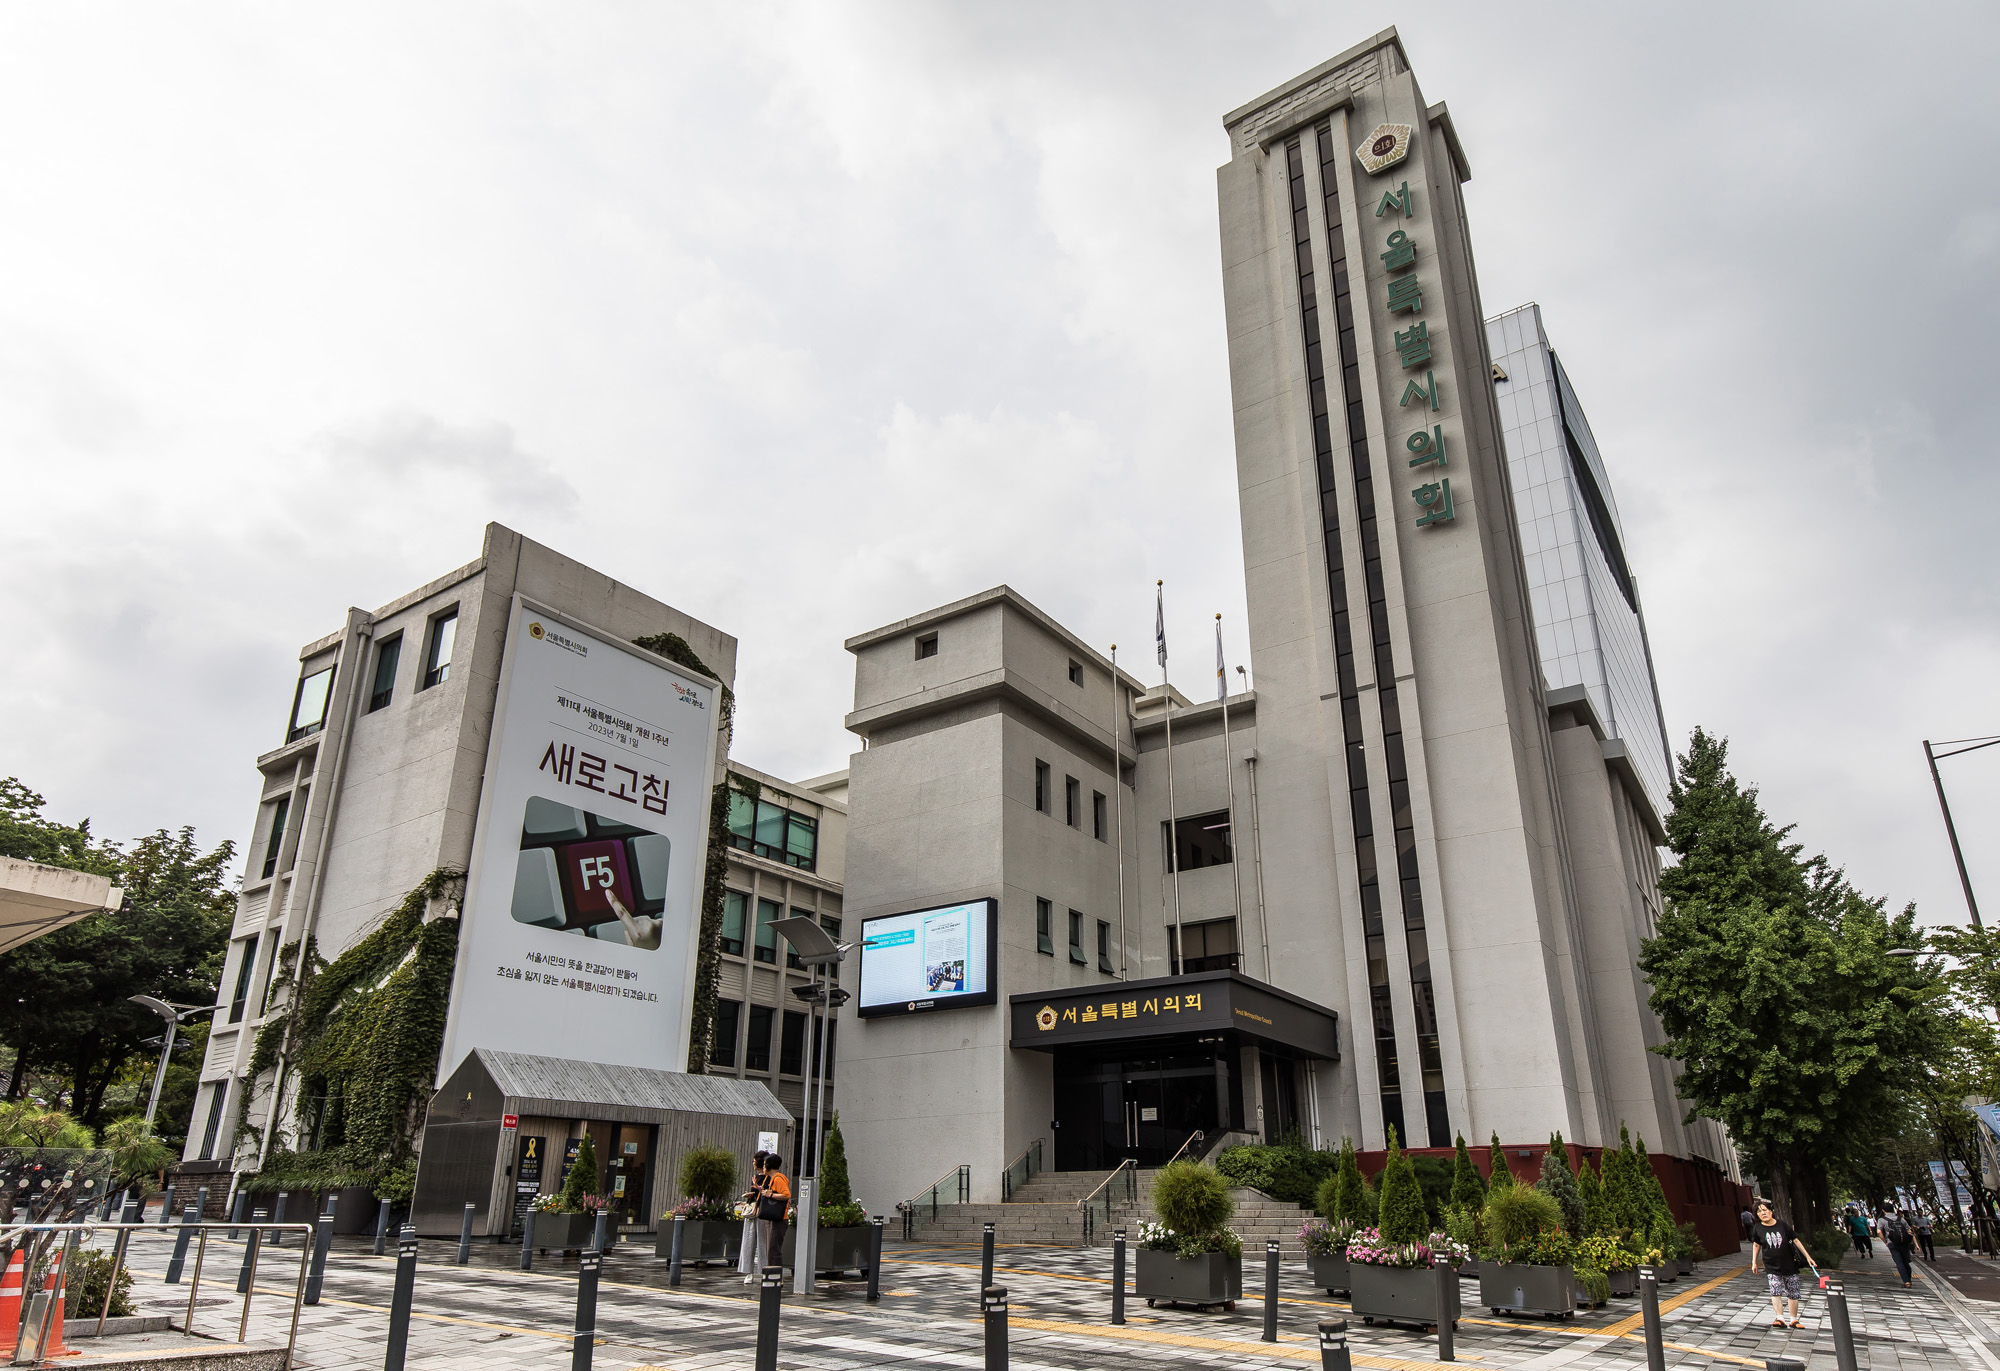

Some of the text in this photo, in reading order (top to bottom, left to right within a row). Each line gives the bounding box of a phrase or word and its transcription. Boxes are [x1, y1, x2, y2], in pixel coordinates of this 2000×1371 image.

[1374, 137, 1396, 154] 의회
[1376, 180, 1455, 528] 서울특별시의회
[546, 631, 588, 654] 서울특별시의회
[557, 696, 669, 747] 제11대 서울특별시의회 개원 1주년
[588, 722, 639, 748] 2023년 7월 1일
[539, 740, 670, 816] 새로고침
[579, 856, 615, 891] F5
[526, 951, 638, 981] 서울시민의 뜻을 한결같이 받들어
[496, 966, 659, 1003] 초심을 잃지 않는 서울특별시의회가 되겠습니다.
[1063, 993, 1202, 1024] 서울특별시의회
